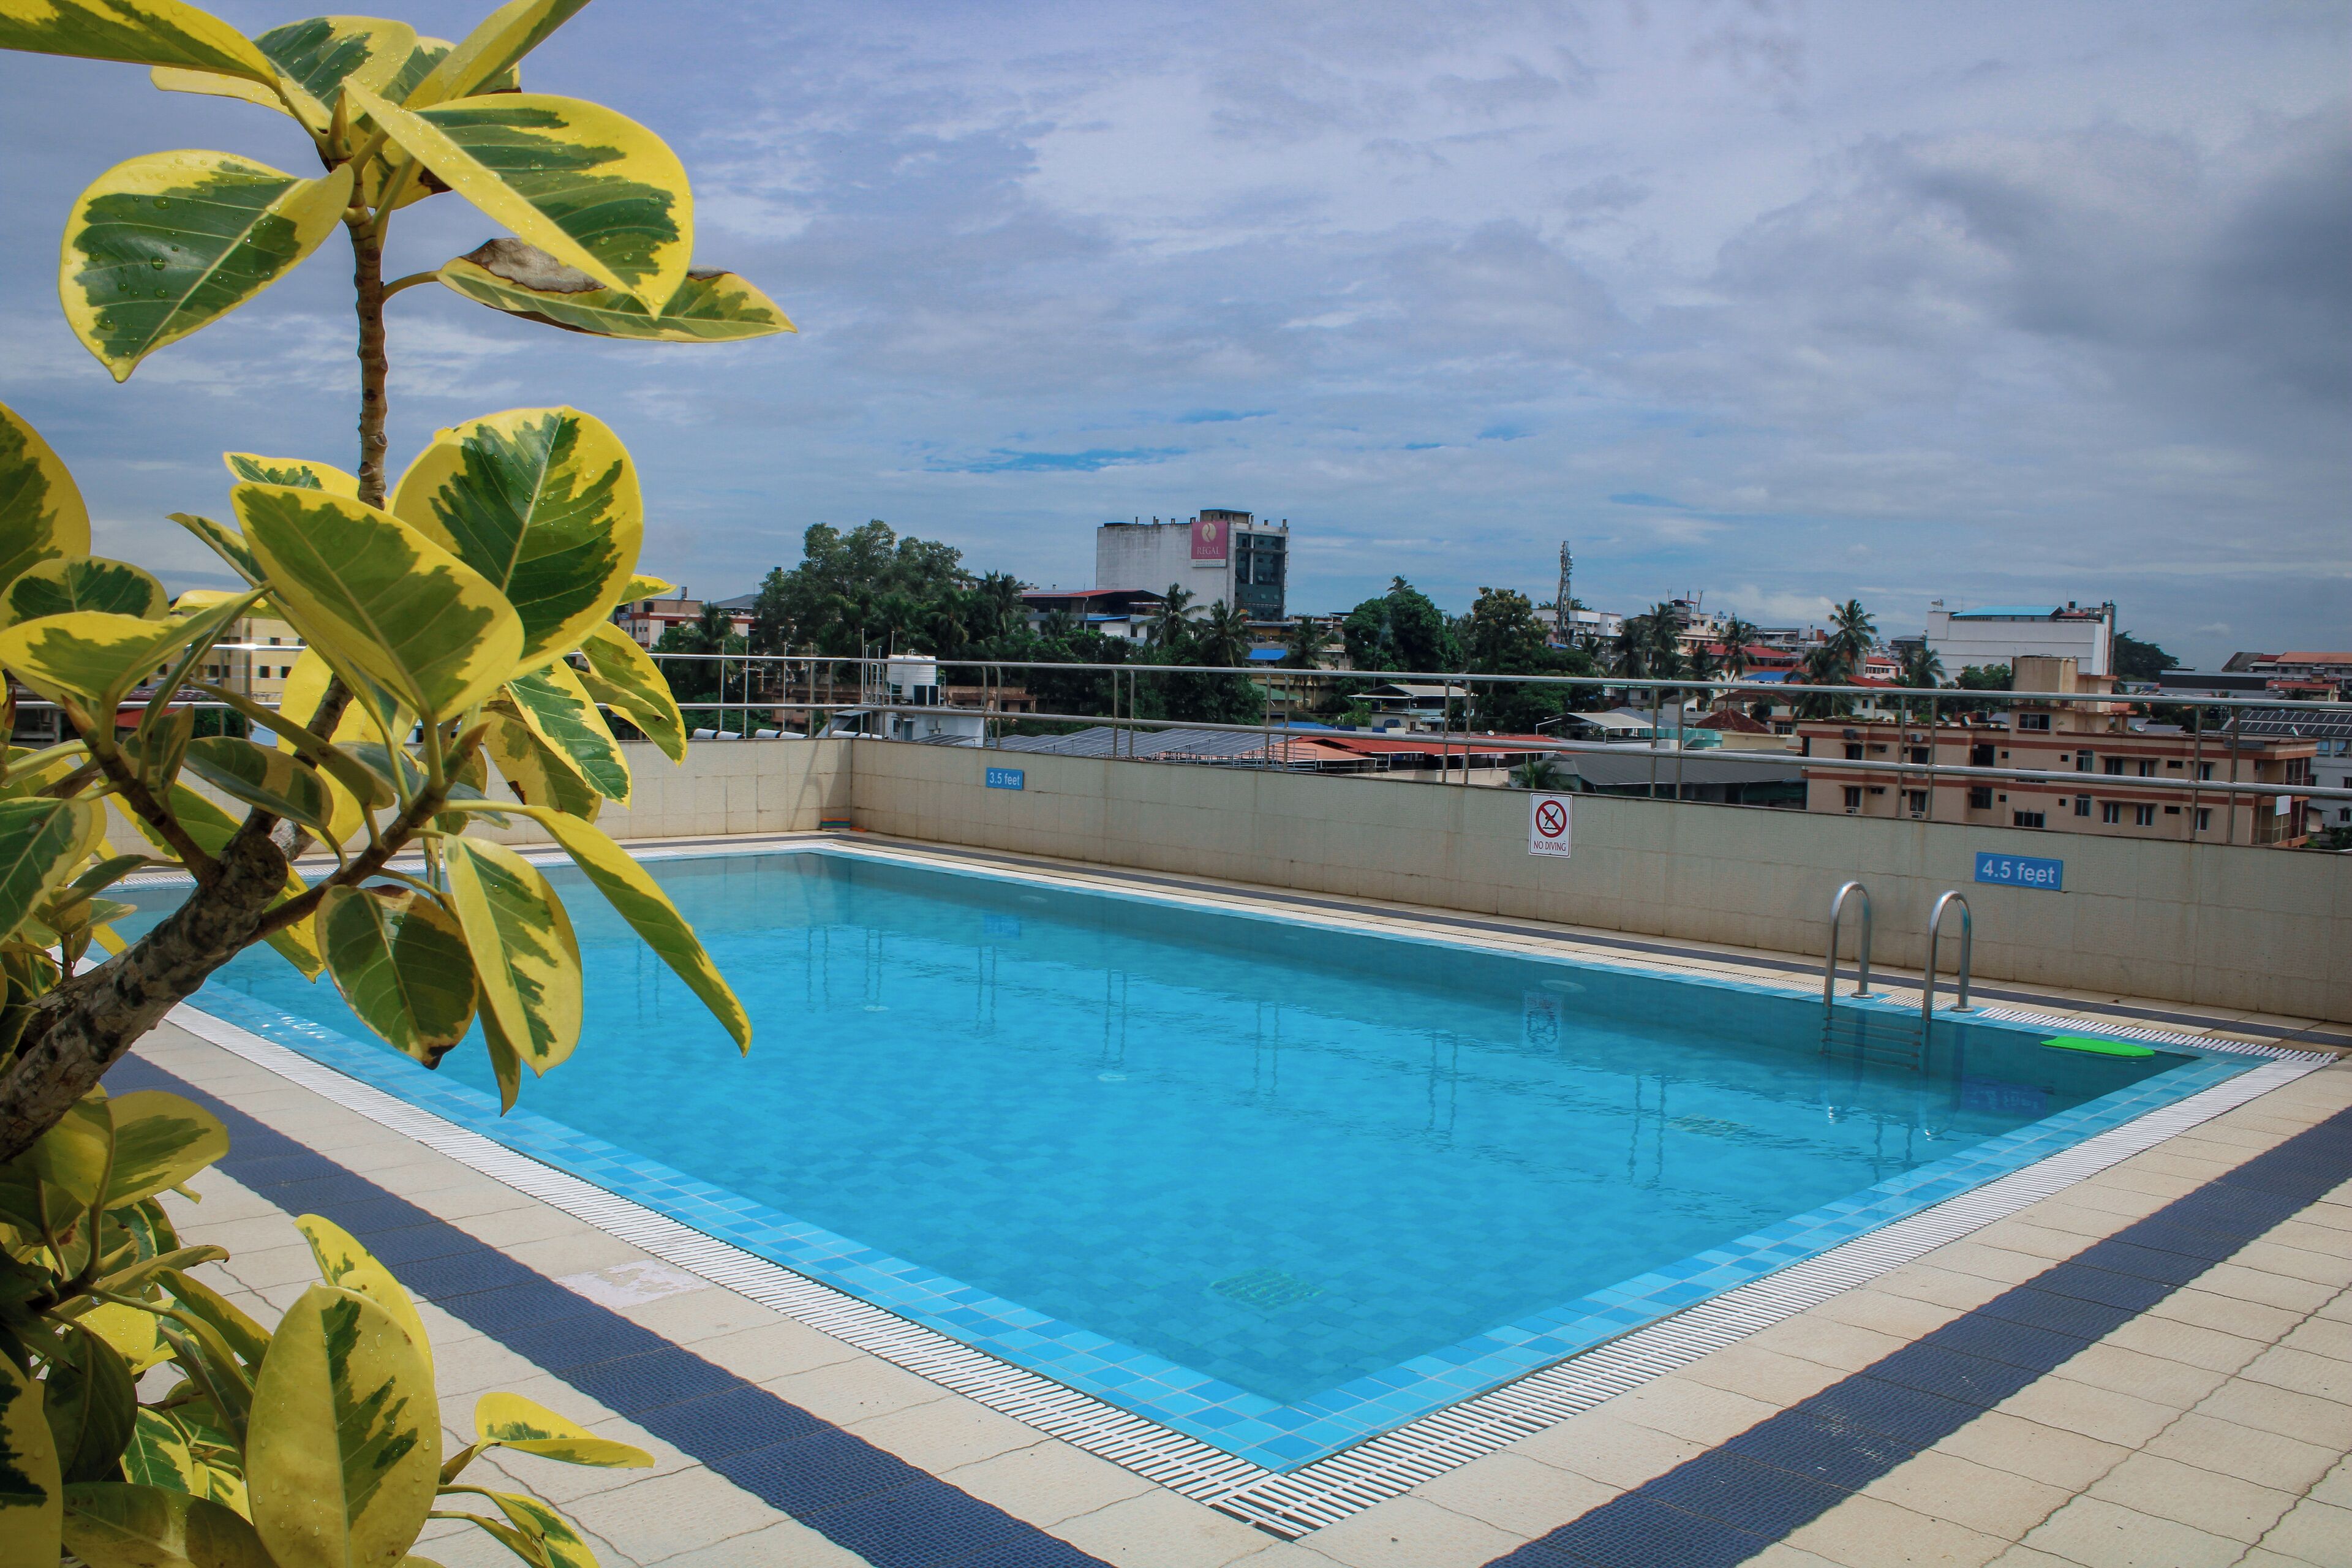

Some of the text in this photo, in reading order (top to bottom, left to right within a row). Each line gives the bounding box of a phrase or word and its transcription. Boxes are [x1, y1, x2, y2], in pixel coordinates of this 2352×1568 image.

[1197, 546, 1220, 555] REGAL
[989, 772, 1020, 786] 3.5 feet
[1533, 840, 1566, 851] NO DIVING
[1982, 859, 2055, 884] 4.5 feet
